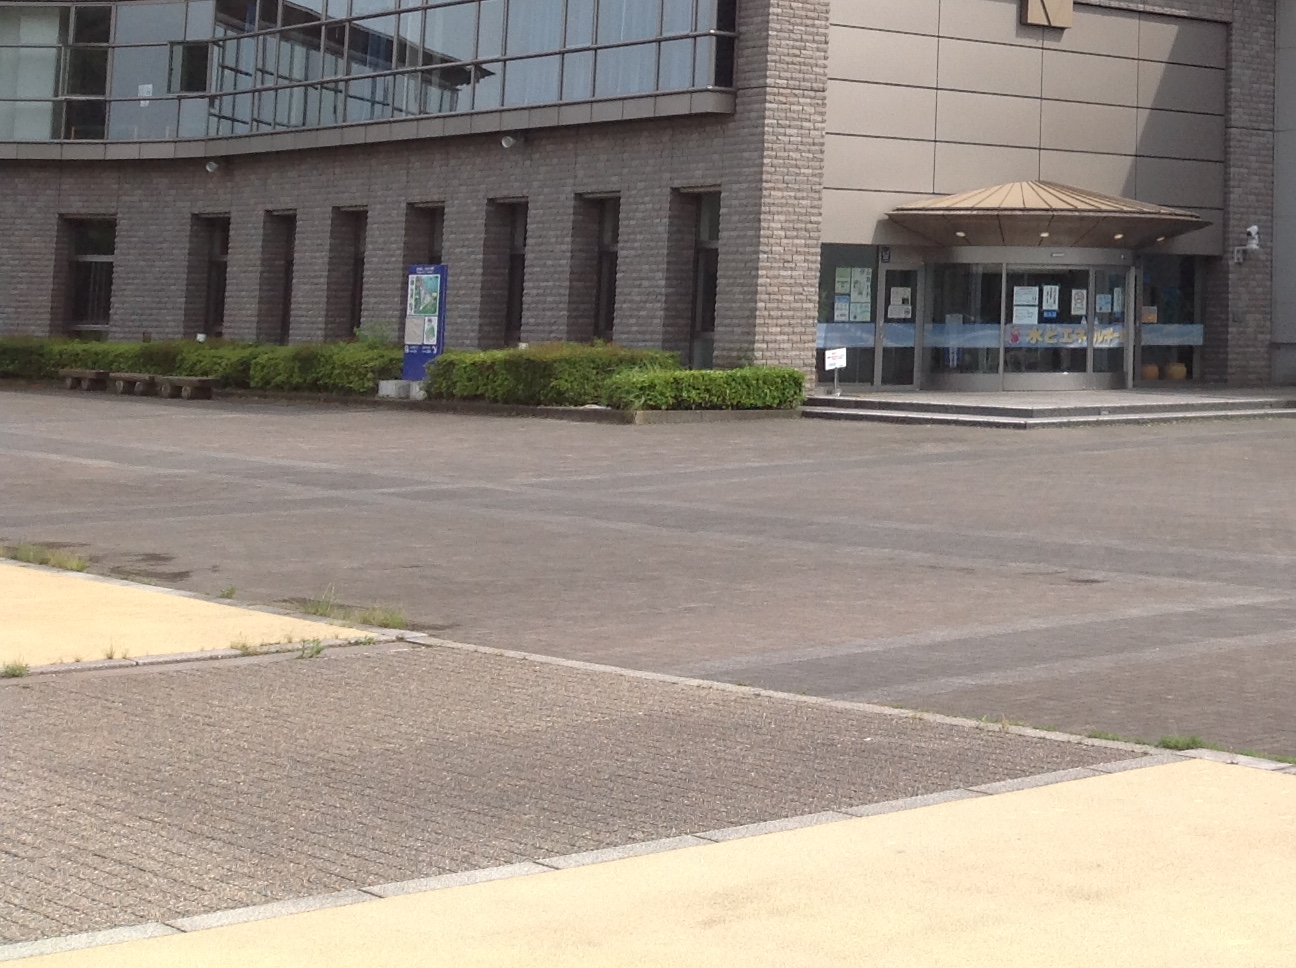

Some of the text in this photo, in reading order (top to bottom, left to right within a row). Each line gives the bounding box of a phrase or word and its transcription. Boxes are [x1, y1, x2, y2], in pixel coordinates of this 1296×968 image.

[1026, 328, 1125, 344] 水とエネルギー
